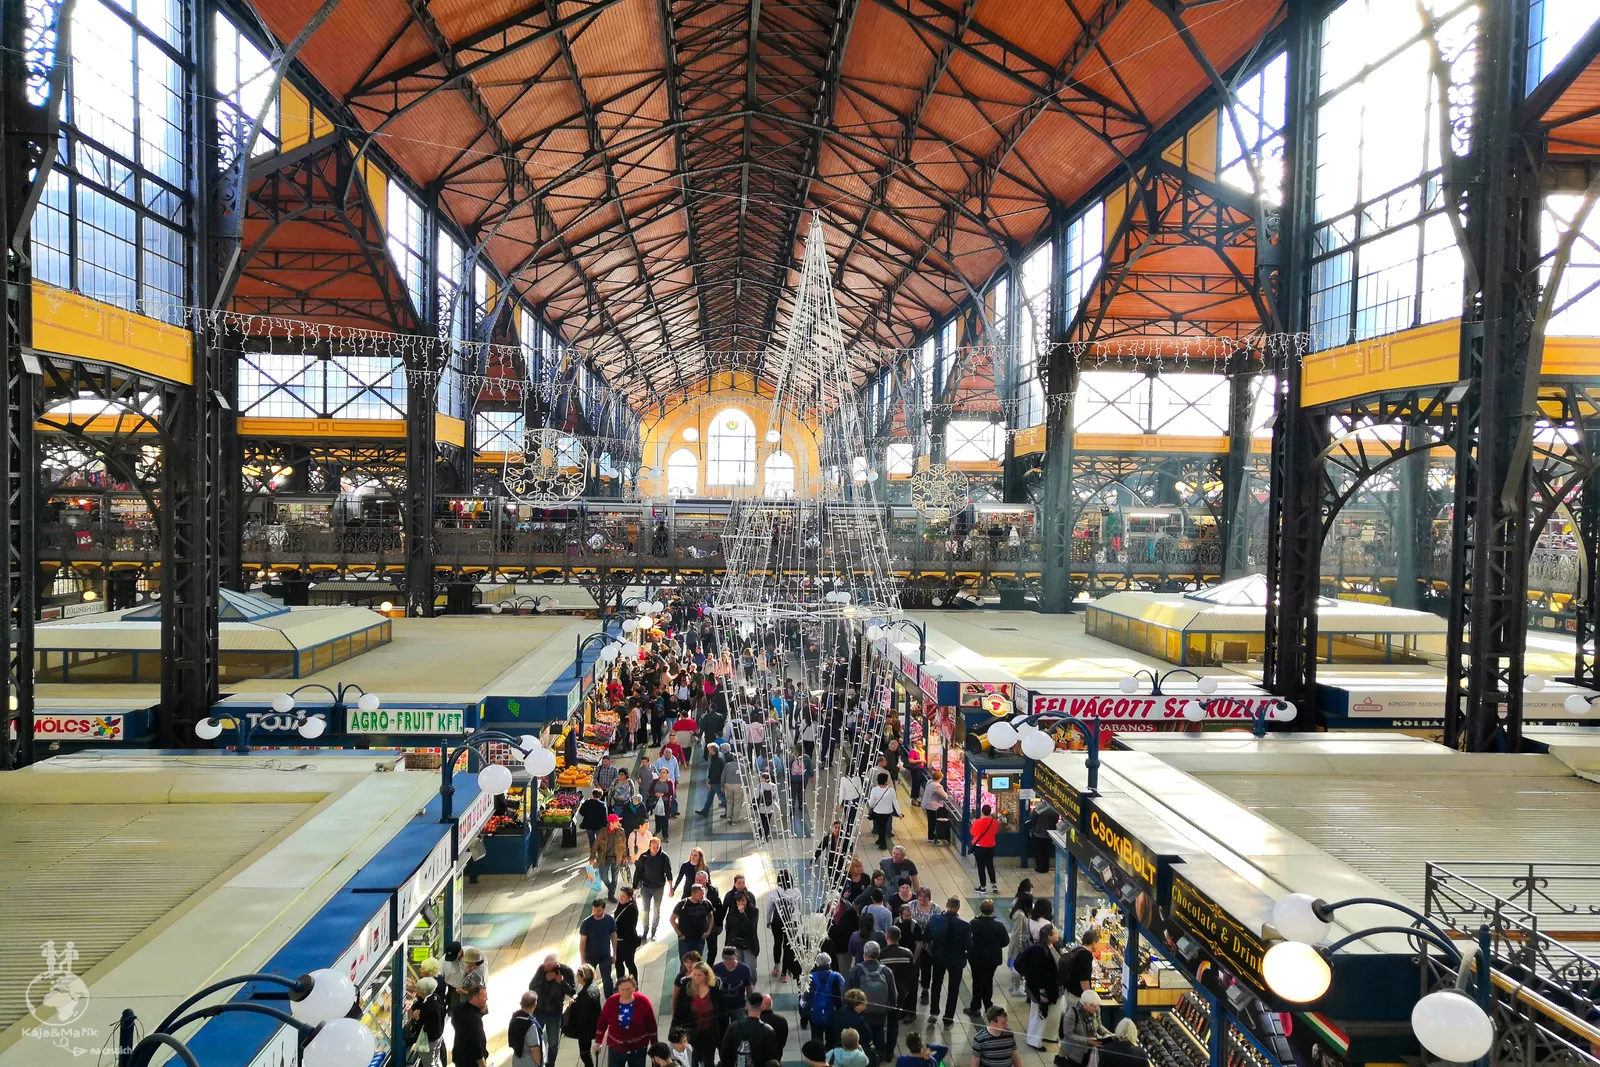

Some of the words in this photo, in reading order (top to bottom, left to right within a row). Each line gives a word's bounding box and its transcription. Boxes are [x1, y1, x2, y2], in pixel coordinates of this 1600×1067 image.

[1034, 696, 1156, 718] FELVÁGOTT
[351, 711, 434, 731] AGRO-FRUIT
[437, 713, 463, 732] KFT.
[1171, 884, 1217, 935] Chocolate
[1220, 926, 1229, 944] &
